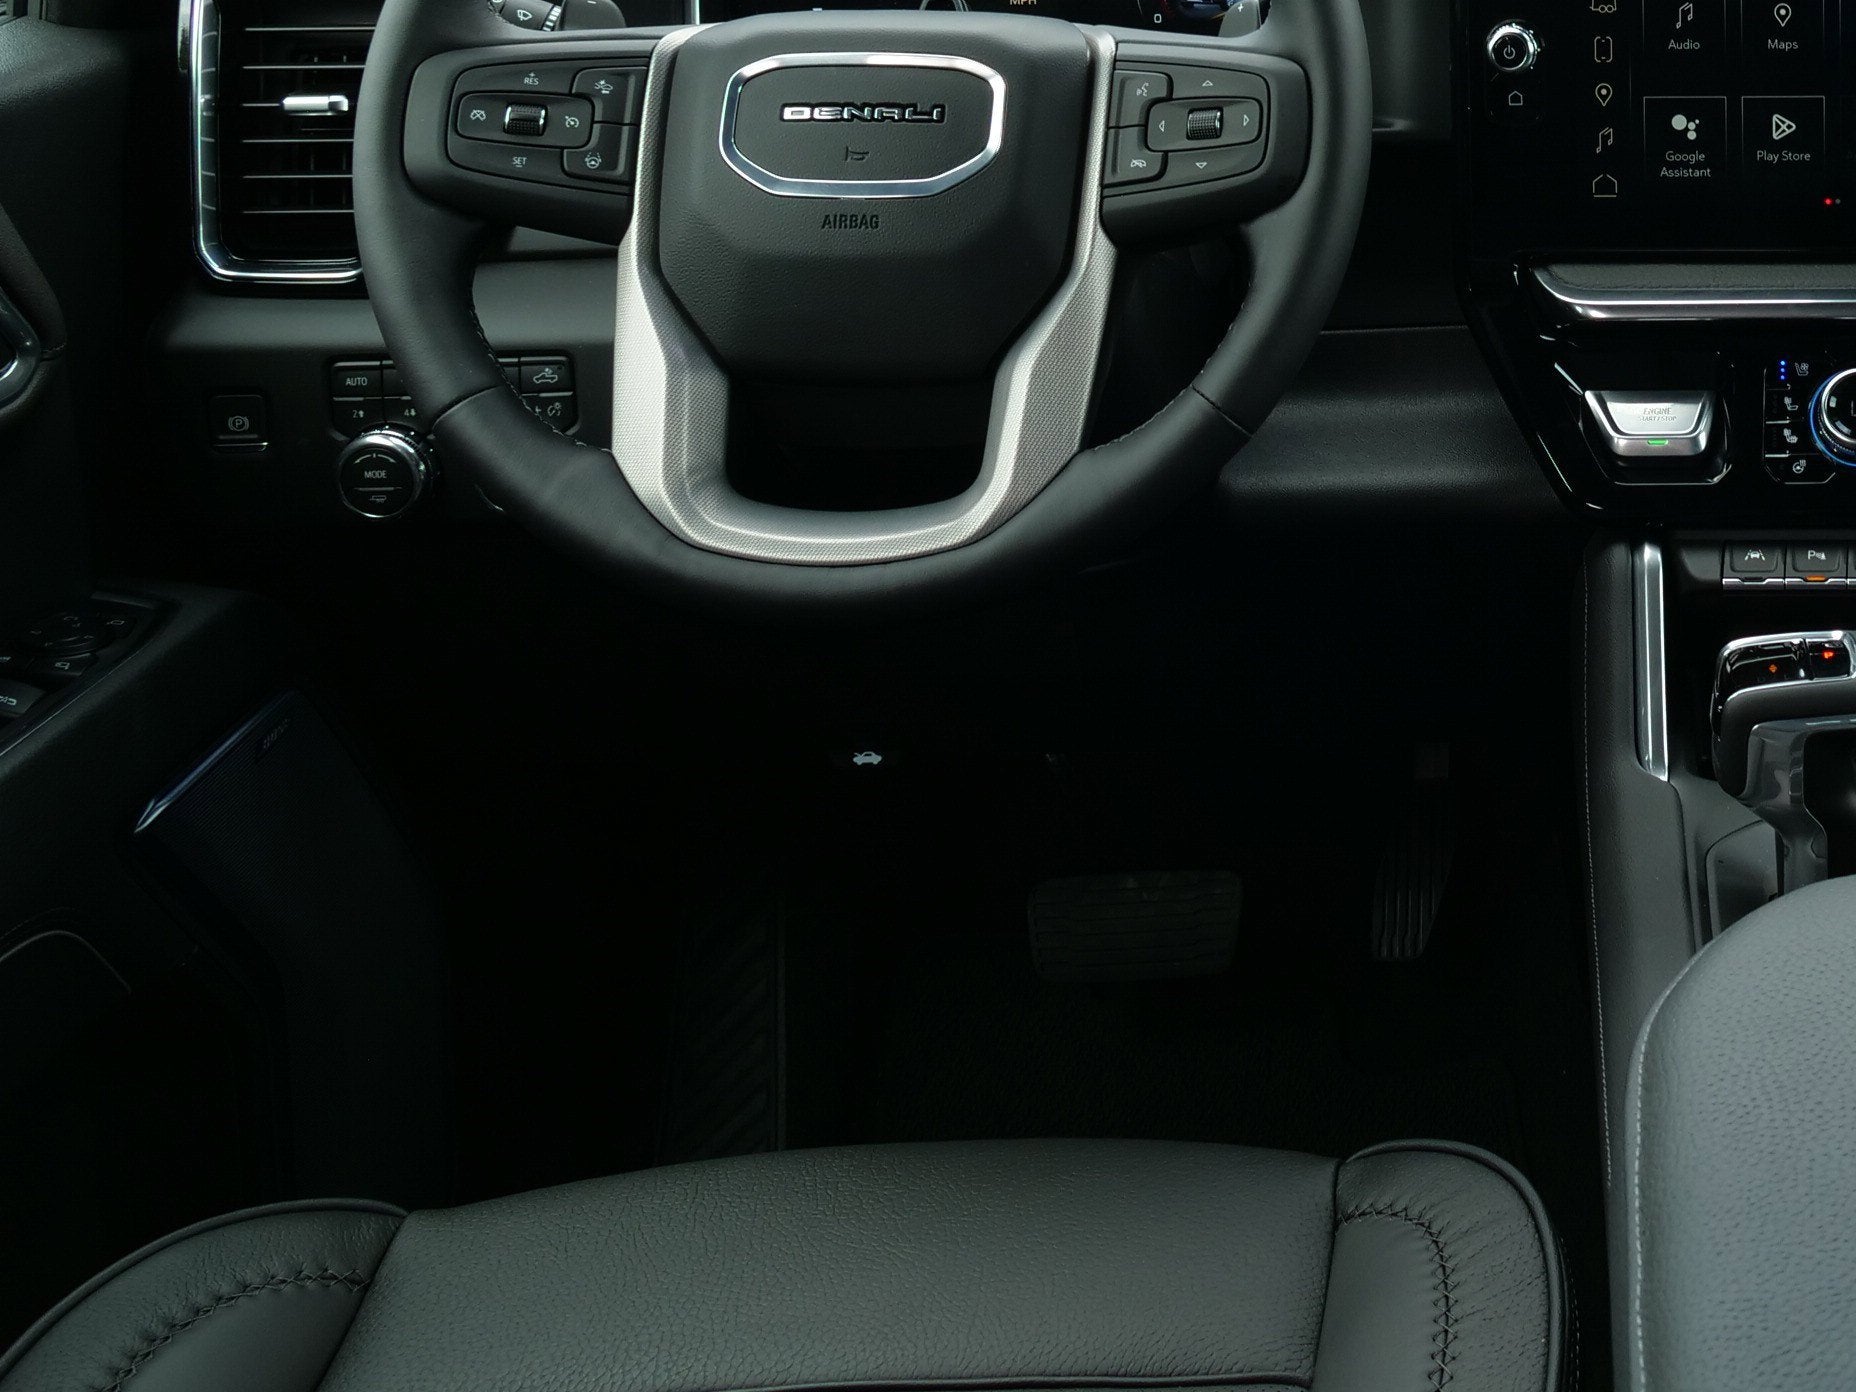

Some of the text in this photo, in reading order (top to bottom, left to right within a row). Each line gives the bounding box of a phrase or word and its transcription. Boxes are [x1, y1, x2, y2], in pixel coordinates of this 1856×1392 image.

[1153, 13, 1162, 25] 0
[1668, 38, 1701, 50] Audio
[1767, 38, 1799, 52] Maps
[782, 106, 943, 121] DENALI
[1665, 150, 1706, 165] Google
[1757, 150, 1811, 164] Play Store
[1660, 166, 1712, 179] Assistant
[822, 213, 881, 230] AIRBAG
[345, 376, 368, 388] AUTO
[1643, 407, 1672, 416] ENGINE
[1638, 415, 1678, 423] START/STOP
[364, 469, 387, 480] MODE
